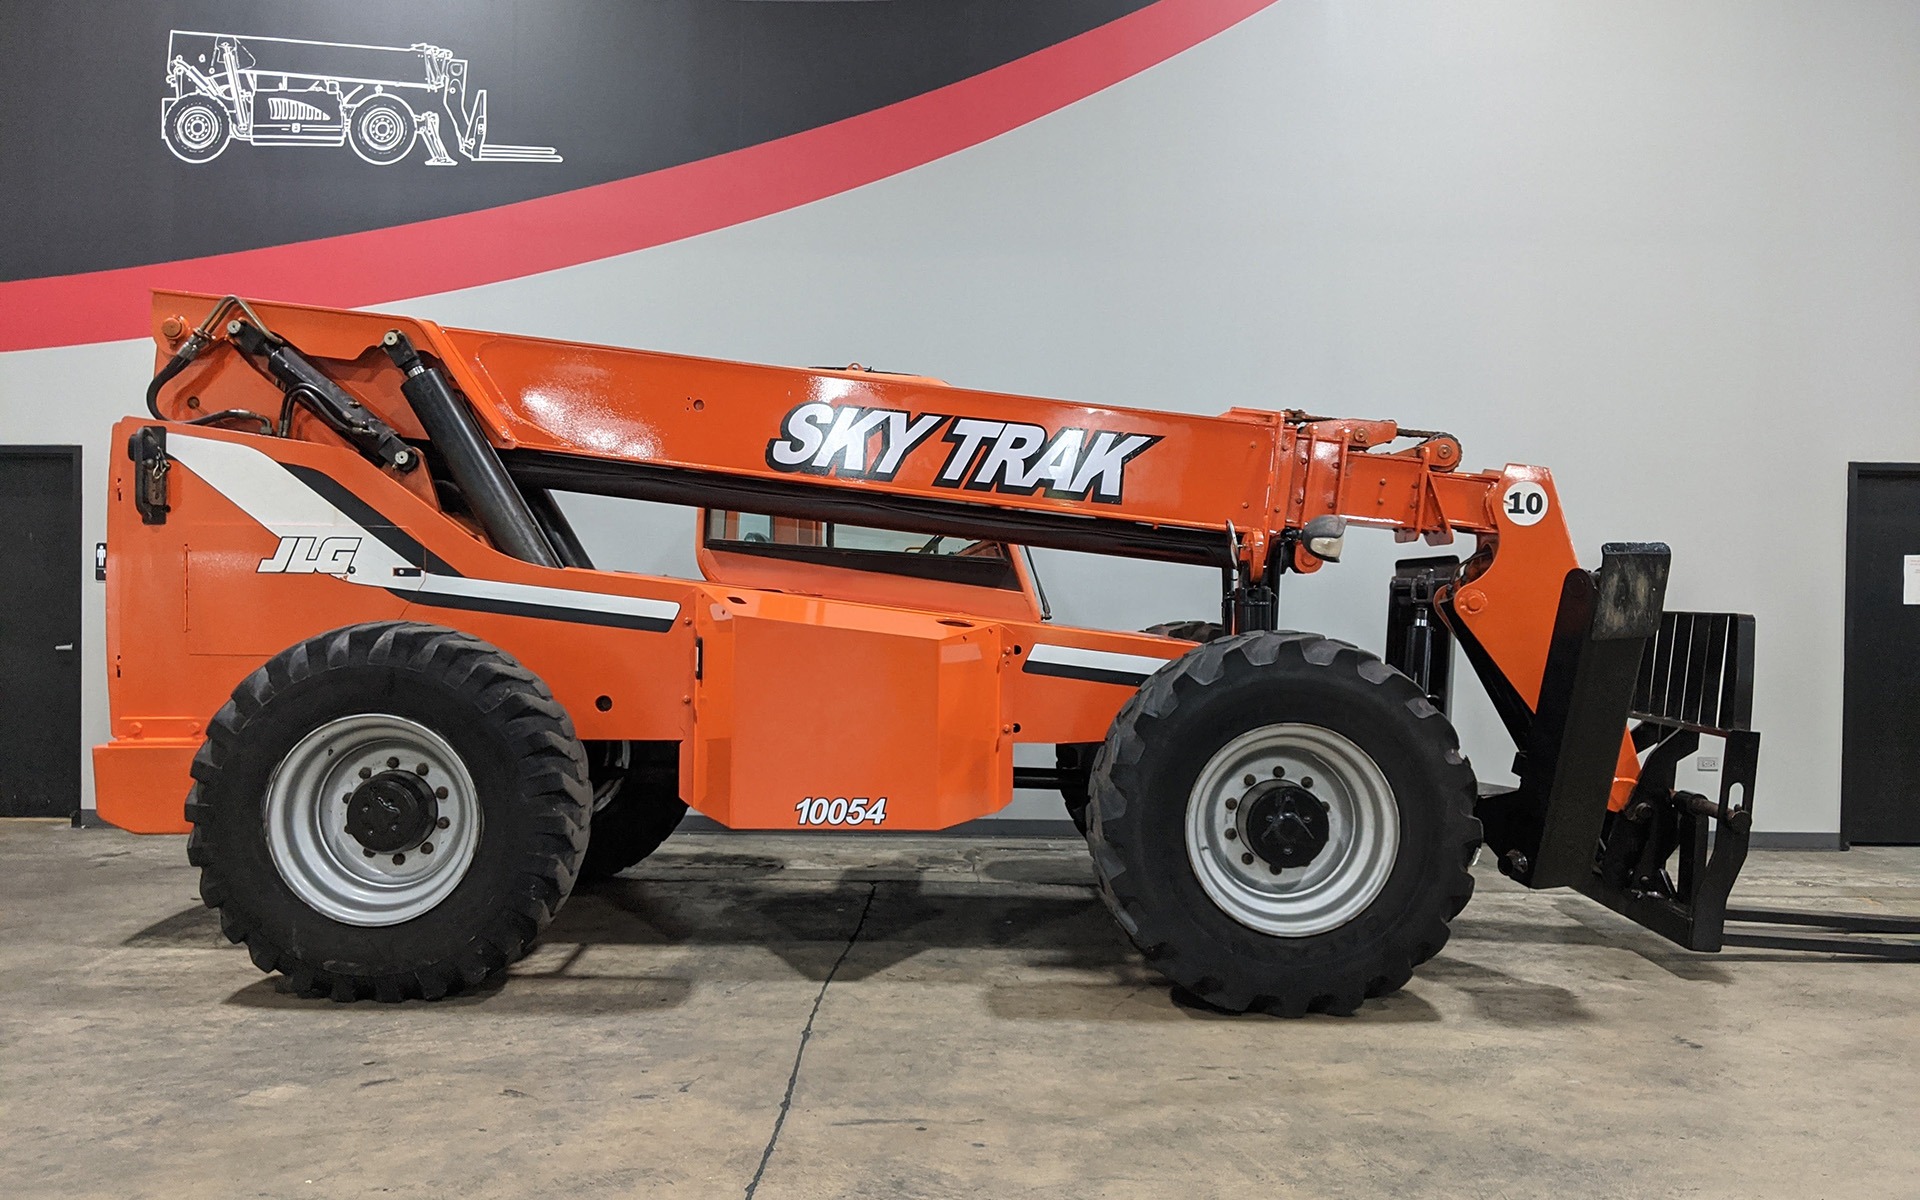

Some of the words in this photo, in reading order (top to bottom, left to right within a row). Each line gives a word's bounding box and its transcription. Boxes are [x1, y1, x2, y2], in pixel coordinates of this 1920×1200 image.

[767, 402, 947, 480] SKY
[933, 416, 1164, 503] TRAK
[1508, 491, 1543, 515] 10
[794, 797, 887, 825] 10054
